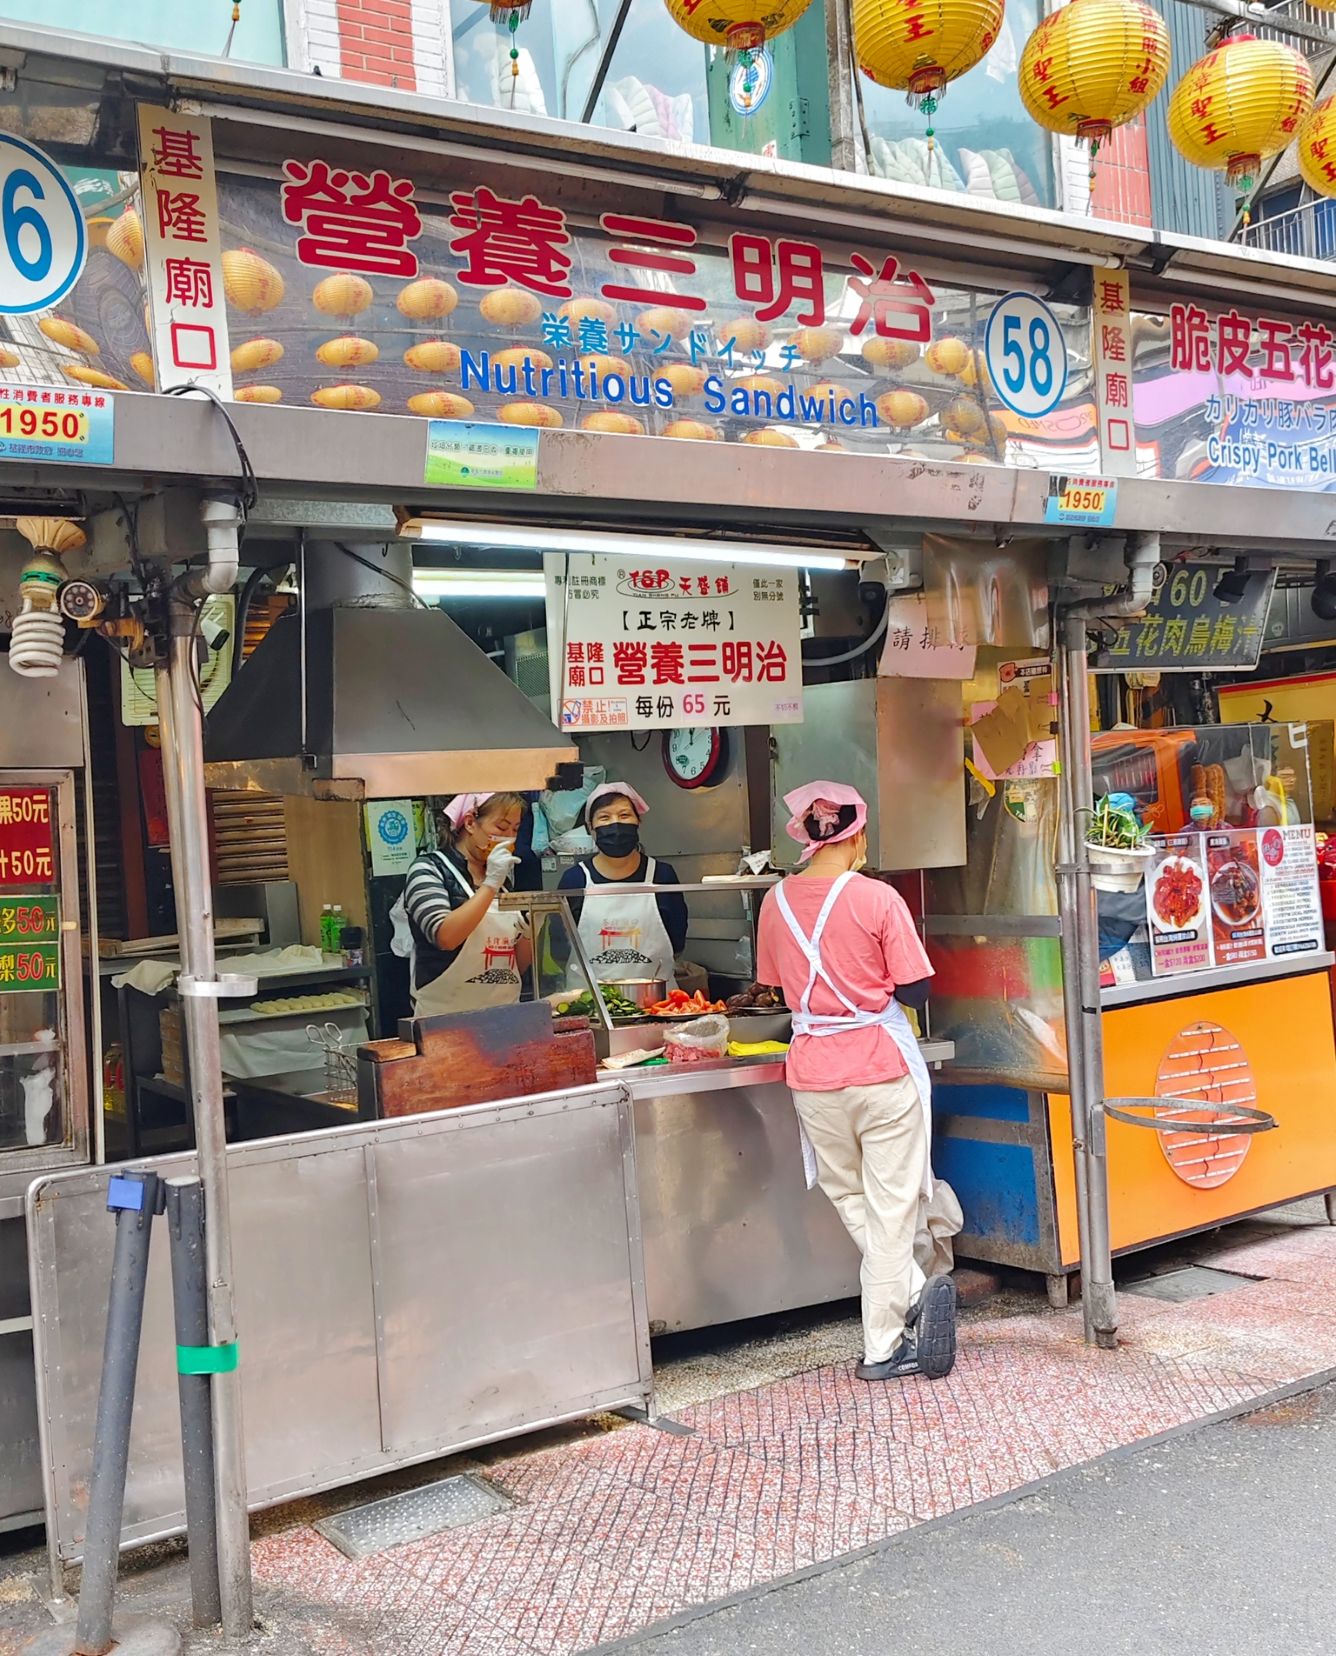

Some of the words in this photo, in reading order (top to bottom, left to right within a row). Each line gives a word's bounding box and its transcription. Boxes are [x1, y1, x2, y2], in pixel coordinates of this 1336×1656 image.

[150, 127, 217, 371] 基隆廟口
[280, 158, 936, 340] 營養三明治
[539, 311, 802, 373] 栄養サンドイッチ
[1002, 312, 1053, 394] 58
[1170, 302, 1334, 390] 脆皮五花
[1099, 280, 1131, 452] 基隆廟口
[460, 350, 673, 410] Nutritious
[703, 374, 878, 428] Sandwich
[0, 407, 79, 439] 1950
[1208, 436, 1260, 475] Crispy
[1269, 442, 1301, 470] Pork
[1064, 490, 1101, 510] 1950
[567, 642, 604, 663] 基隆
[613, 640, 787, 685] 營養三明治
[568, 665, 604, 687] 廟口
[635, 695, 674, 718] 每份
[683, 693, 705, 714] 65
[713, 695, 731, 717] 元
[1283, 829, 1312, 841] MENU
